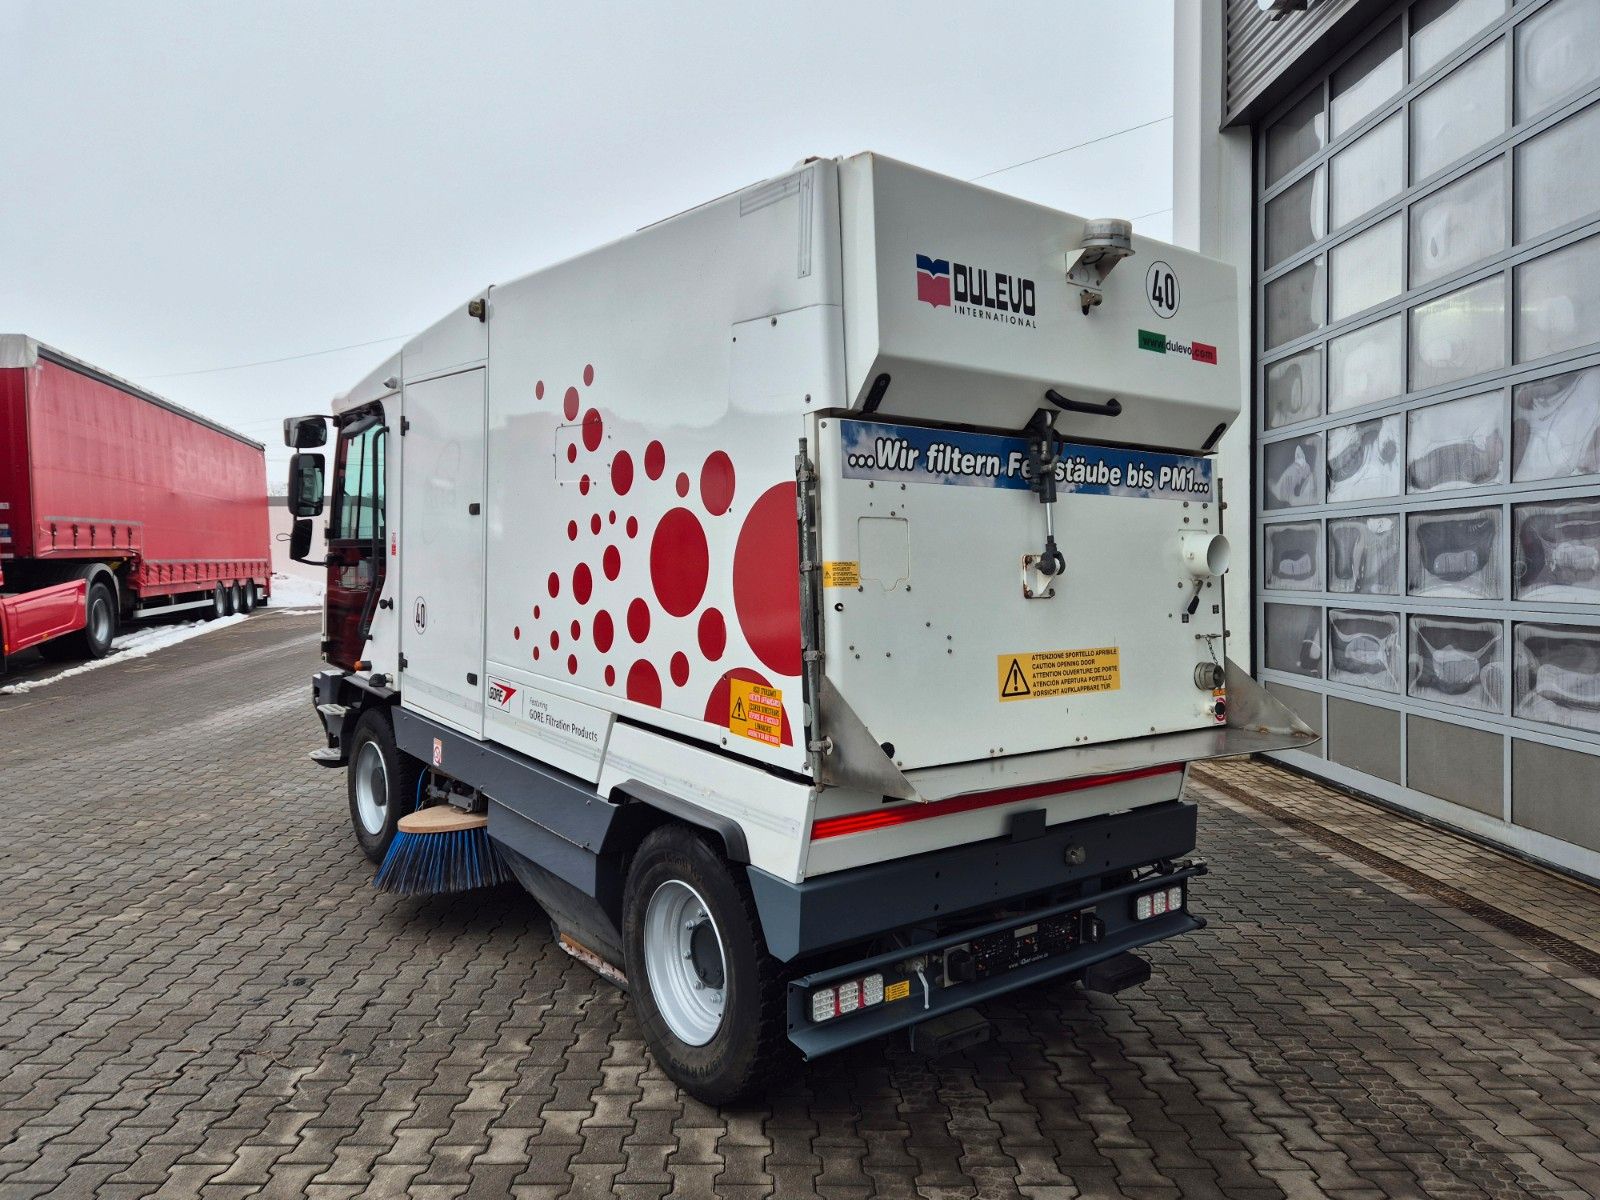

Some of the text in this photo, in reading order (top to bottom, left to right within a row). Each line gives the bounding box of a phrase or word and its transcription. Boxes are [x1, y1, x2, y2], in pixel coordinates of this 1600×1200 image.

[953, 262, 1036, 317] DULEVO
[1152, 269, 1175, 311] 40
[954, 305, 1037, 329] INTERNATIONAL
[1142, 336, 1214, 360] www.dulevo.com
[927, 443, 1001, 477] filtern
[1007, 450, 1122, 487] Festäube
[1126, 462, 1155, 490] bis
[415, 602, 425, 628] 40
[1031, 652, 1064, 661] ATTENZIONE
[1065, 650, 1095, 659] SPORTELLO
[1031, 661, 1056, 670] CAUTION
[1057, 660, 1080, 668] OPENING
[1032, 670, 1061, 679] ATTENTION
[1063, 668, 1093, 676] OUVERTURE
[1061, 677, 1087, 685] APERTURA
[488, 686, 503, 703] GORE
[1033, 688, 1060, 697] VORSICHT
[528, 708, 598, 742] GORE Filtration Products
